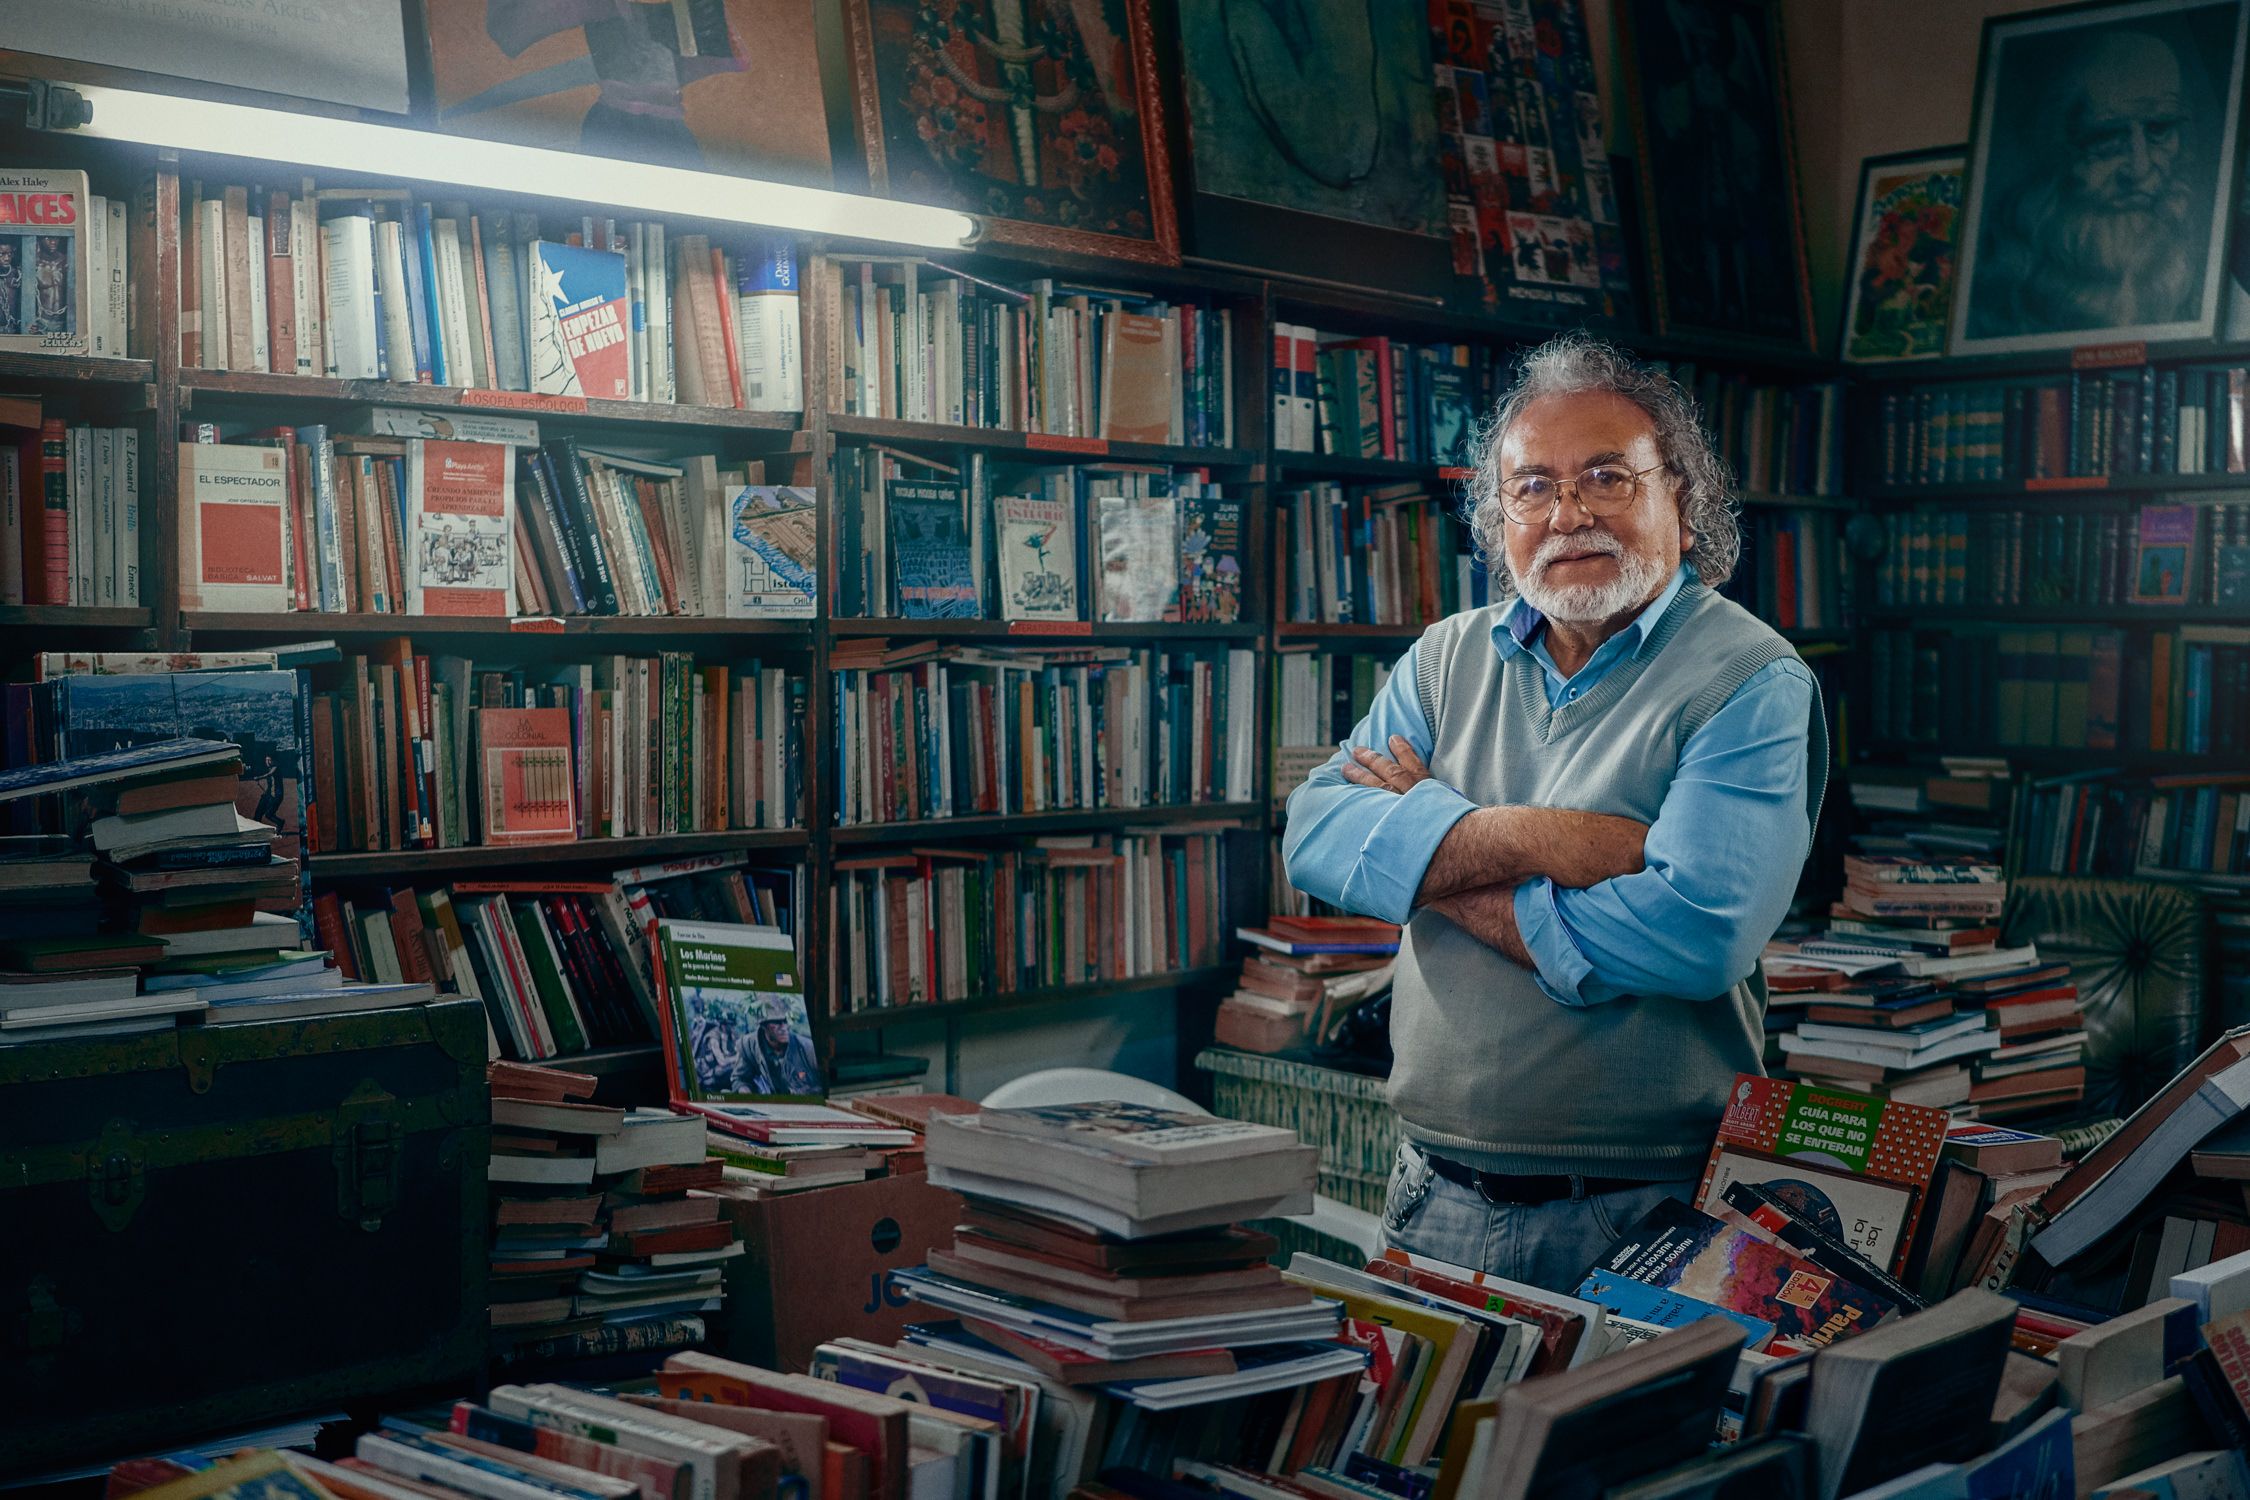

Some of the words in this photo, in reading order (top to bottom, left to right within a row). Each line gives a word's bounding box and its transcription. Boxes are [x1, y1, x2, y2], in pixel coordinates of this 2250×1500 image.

[23, 177, 49, 188] Haley
[0, 193, 77, 226] AICES
[561, 303, 619, 341] EMPEZAR
[566, 337, 588, 360] DE
[583, 322, 626, 354] NUEVO
[126, 451, 136, 493] Leonard
[199, 474, 212, 484] EL
[214, 476, 281, 488] ESPECTADOR
[127, 504, 137, 533] Brillo
[128, 565, 138, 601] Emecé
[680, 947, 694, 960] Los
[695, 948, 727, 963] Marines
[1728, 1103, 1760, 1122] DILBERT
[1807, 1093, 1870, 1113] DOGBERT
[1799, 1105, 1830, 1120] GUÍA
[1832, 1112, 1868, 1128] PARA
[1791, 1118, 1816, 1133] LOS
[1818, 1123, 1844, 1138] QUE
[1846, 1129, 1867, 1143] NO
[1784, 1132, 1802, 1145] SE
[1803, 1136, 1865, 1157] ENTERAN
[1853, 1218, 1869, 1234] la
[1866, 1226, 1883, 1248] las
[1646, 1226, 1677, 1253] ESPIRITUALIDAD
[1665, 1238, 1694, 1263] NUEVOS
[1628, 1260, 1639, 1271] VIDA
[1644, 1241, 1674, 1266] NUEVOS
[1779, 1272, 1803, 1300] EDICIÓN
